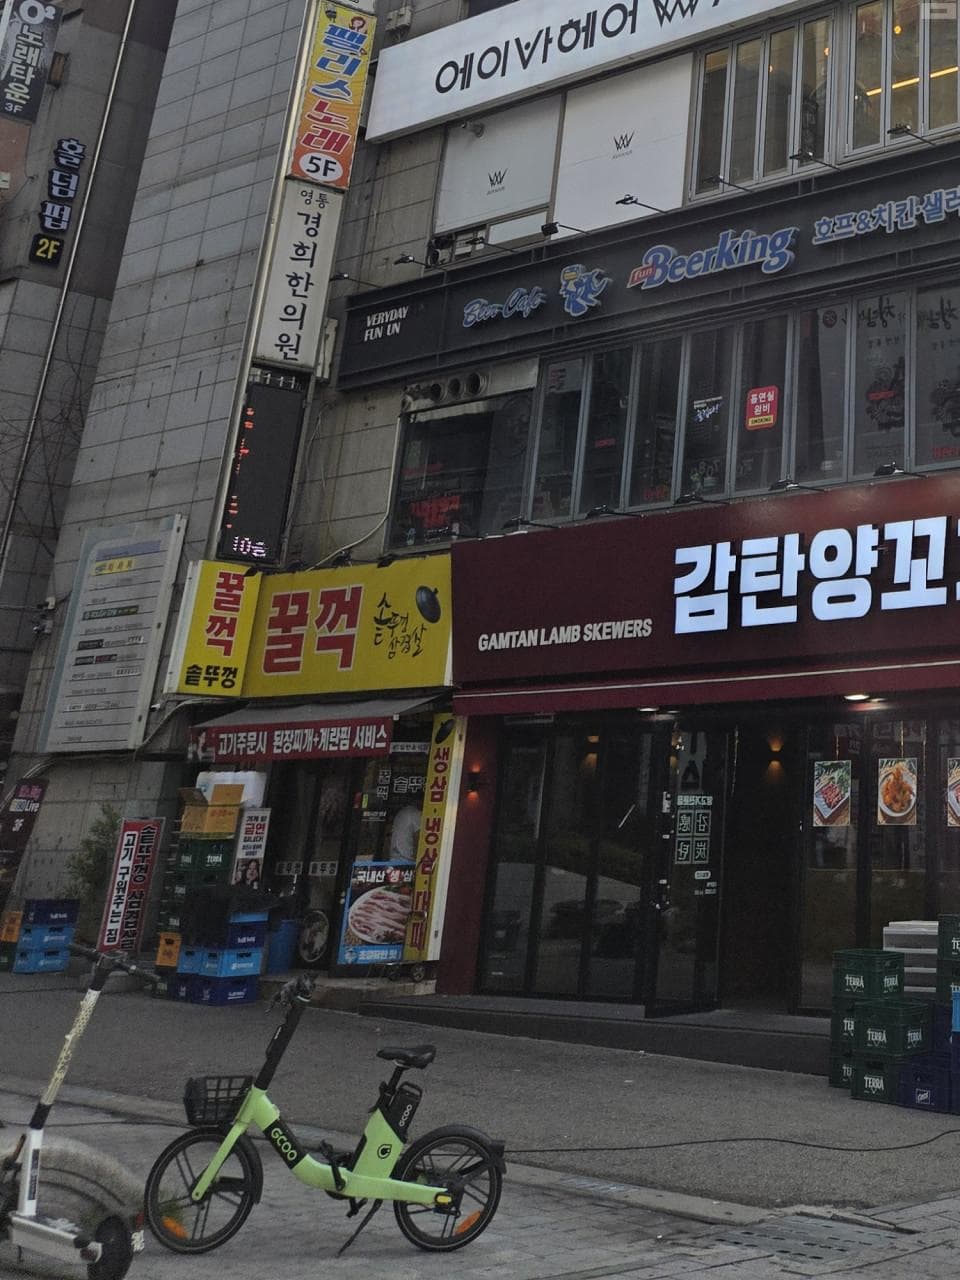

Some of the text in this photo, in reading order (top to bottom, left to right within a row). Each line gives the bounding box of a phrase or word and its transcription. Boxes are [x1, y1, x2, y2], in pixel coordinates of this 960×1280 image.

[4, 24, 45, 105] 노래타운
[311, 23, 367, 105] 팰리스
[4, 102, 24, 113] 3F
[300, 100, 351, 155] 노래
[307, 155, 339, 178] 5F
[43, 138, 86, 230] 홀덤펍
[300, 188, 330, 209] 영통
[36, 238, 61, 260] 2F
[632, 226, 799, 292] fun Beerking
[275, 212, 323, 363] 경희한의원
[366, 306, 409, 327] VERYDAY
[462, 286, 547, 328] Beer Cafe
[364, 328, 382, 342] FUN
[750, 391, 775, 405] 흡연실
[753, 403, 771, 415] 완비
[206, 570, 245, 657] 꿀꺽
[263, 585, 363, 675] 꿀꺽
[388, 622, 428, 661] 삼겹살
[478, 618, 652, 652] GAMTAN LAMB SKEWERS
[185, 663, 238, 689] 솥뚜껑
[217, 730, 267, 756] 고기주문시
[273, 725, 352, 754] 된장찌개+계란찜
[353, 724, 388, 751] 서비스
[430, 747, 450, 803] 생삼
[245, 822, 266, 835] 금연
[106, 833, 137, 944] 고기 구워주는 집
[357, 869, 386, 883] 국내산
[844, 974, 865, 988] TERRA
[883, 974, 899, 988] TERRA
[867, 1028, 887, 1042] TERRA
[907, 1028, 922, 1042] TERRA
[864, 1076, 884, 1090] TERRA
[399, 1103, 413, 1128] GCOO
[269, 1126, 298, 1162] GCOO
